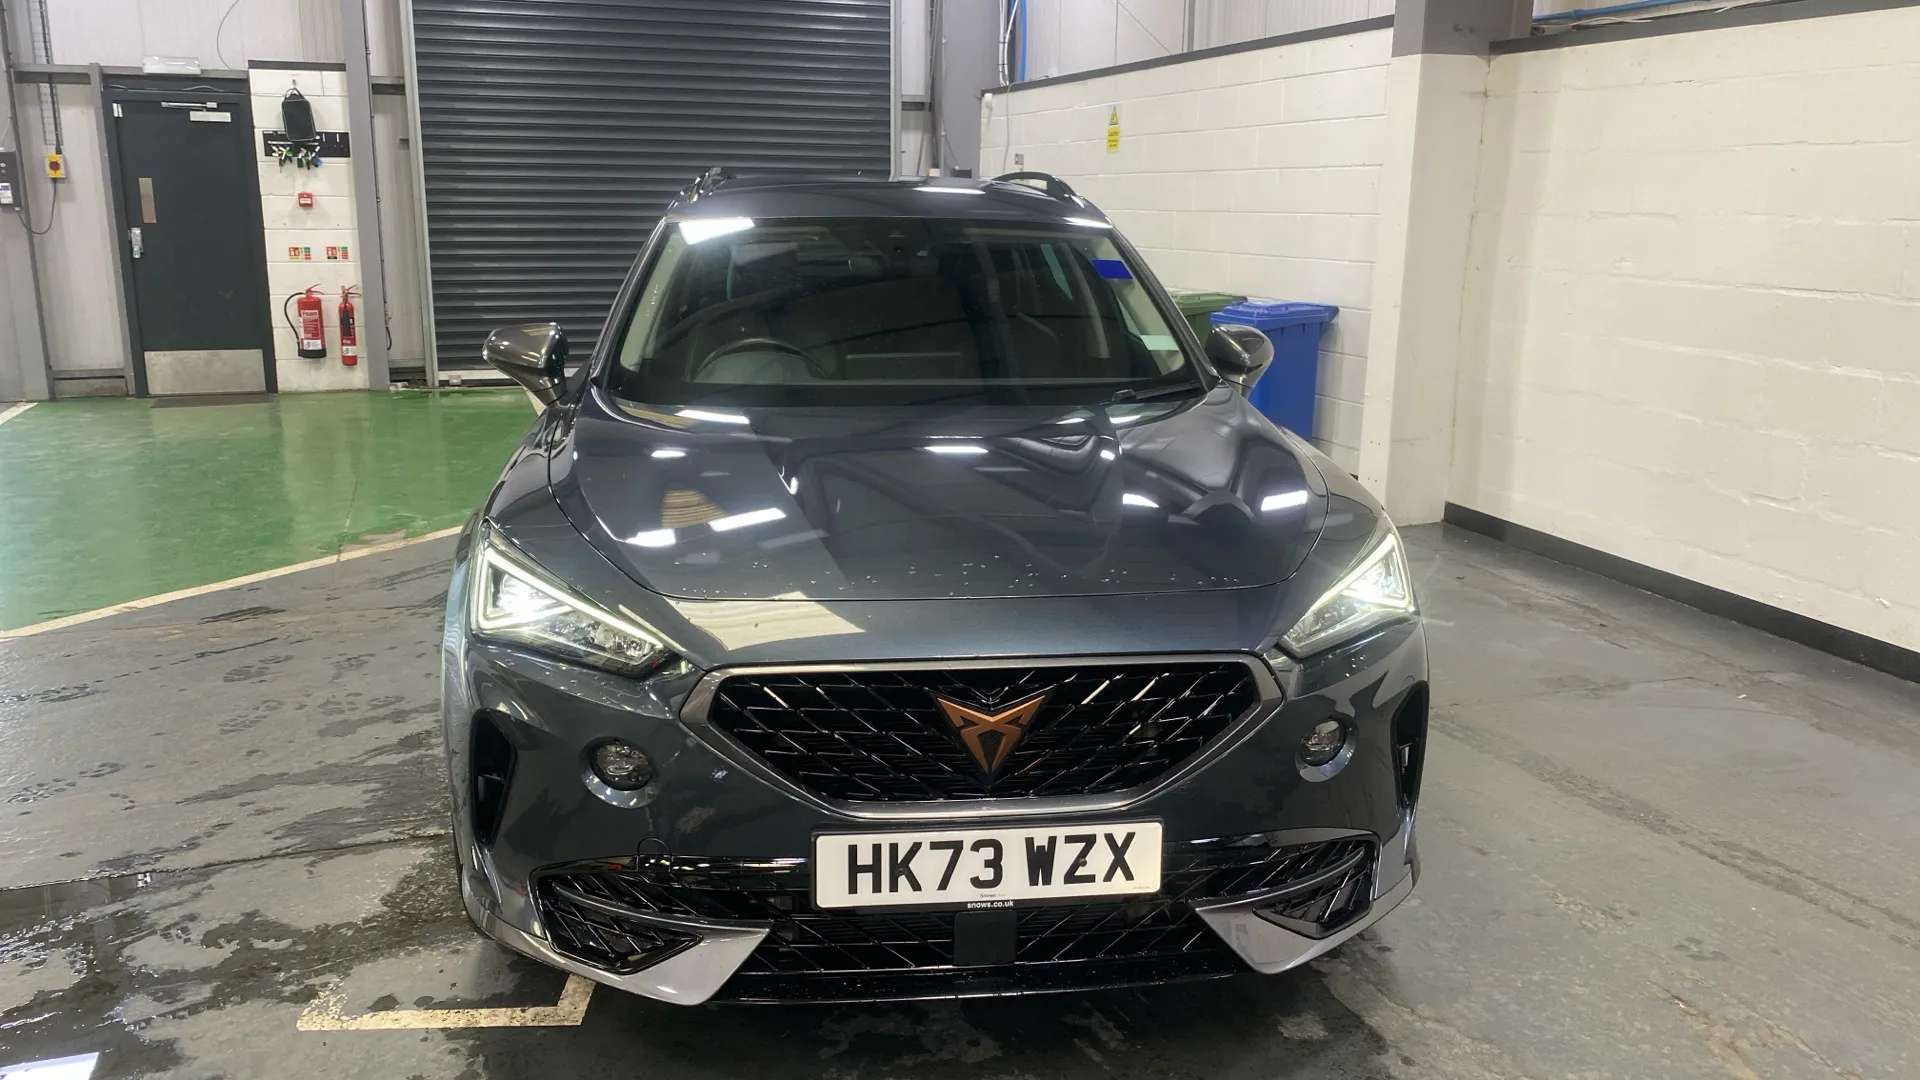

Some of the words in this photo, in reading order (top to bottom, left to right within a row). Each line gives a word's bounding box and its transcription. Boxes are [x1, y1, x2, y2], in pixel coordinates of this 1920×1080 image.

[847, 838, 1004, 895] HK73
[1024, 831, 1136, 887] WZX
[967, 900, 1014, 909] snows.co.uk
